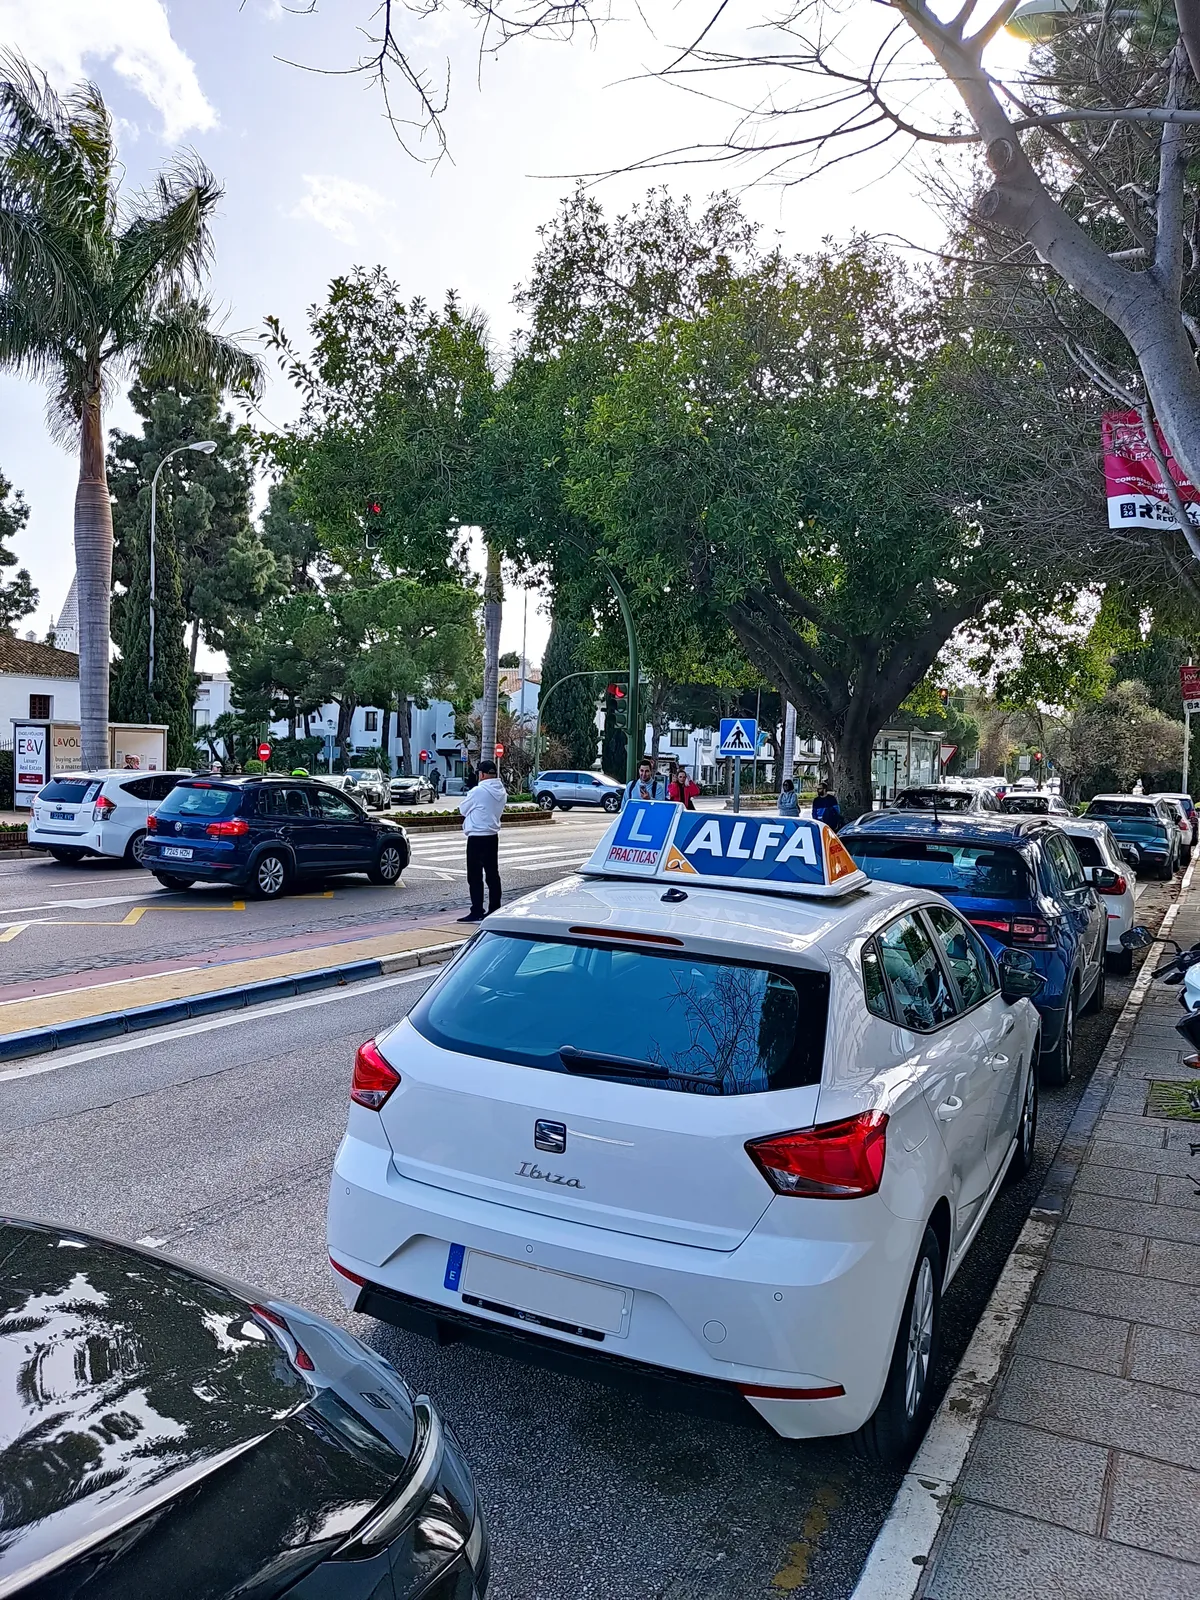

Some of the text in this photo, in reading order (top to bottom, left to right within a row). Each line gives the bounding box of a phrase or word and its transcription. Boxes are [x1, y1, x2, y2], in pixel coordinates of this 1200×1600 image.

[18, 738, 43, 755] E&V
[23, 757, 38, 765] Luxury
[628, 809, 817, 865] L ALFA
[609, 847, 657, 864] PRACTICAS
[514, 1161, 586, 1189] Ibiza
[449, 1271, 456, 1280] E
